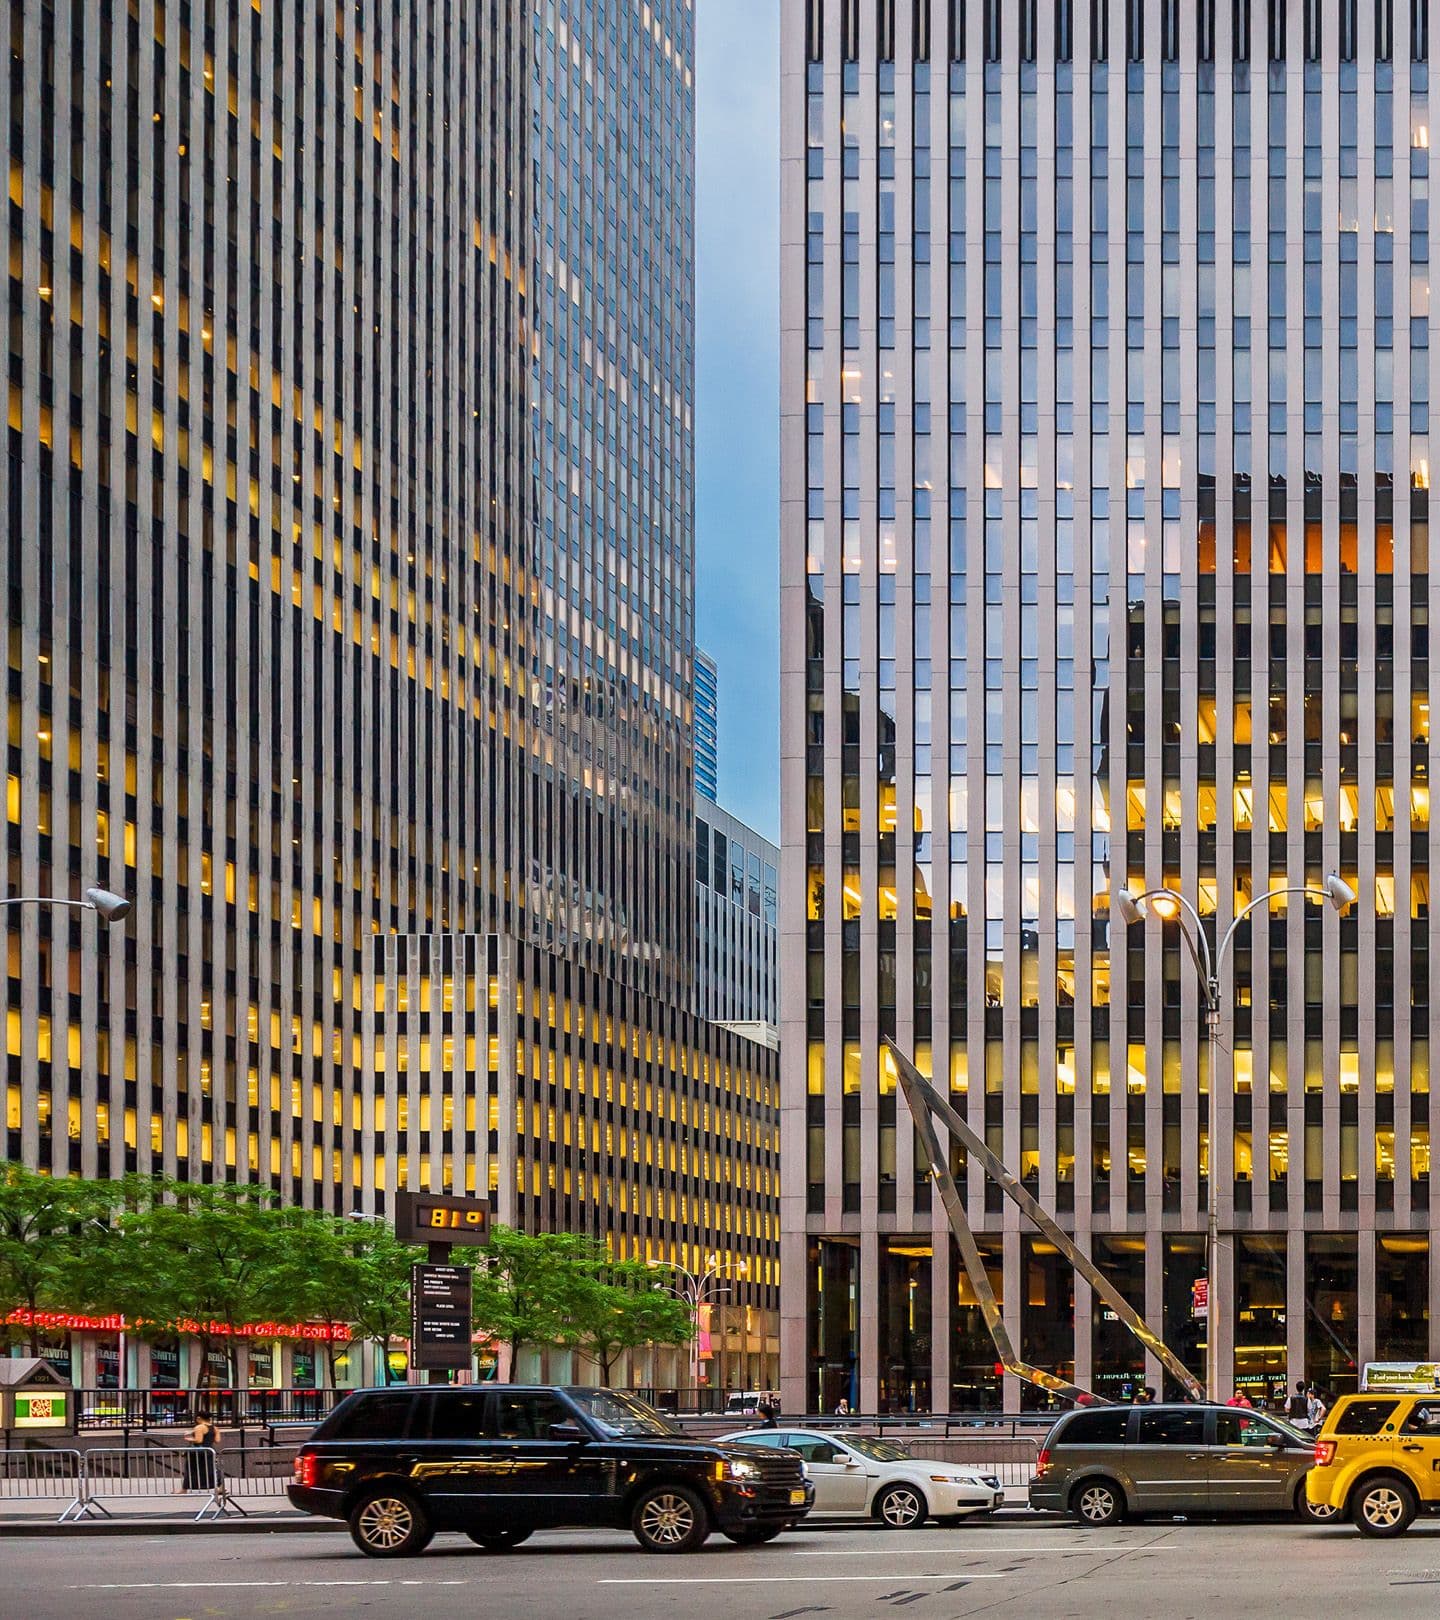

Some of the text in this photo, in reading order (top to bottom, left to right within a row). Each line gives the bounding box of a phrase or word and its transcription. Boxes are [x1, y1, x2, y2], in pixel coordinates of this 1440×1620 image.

[38, 1347, 69, 1359] CAVUTO
[96, 1349, 120, 1360] BAIE
[151, 1350, 177, 1361] SMITH
